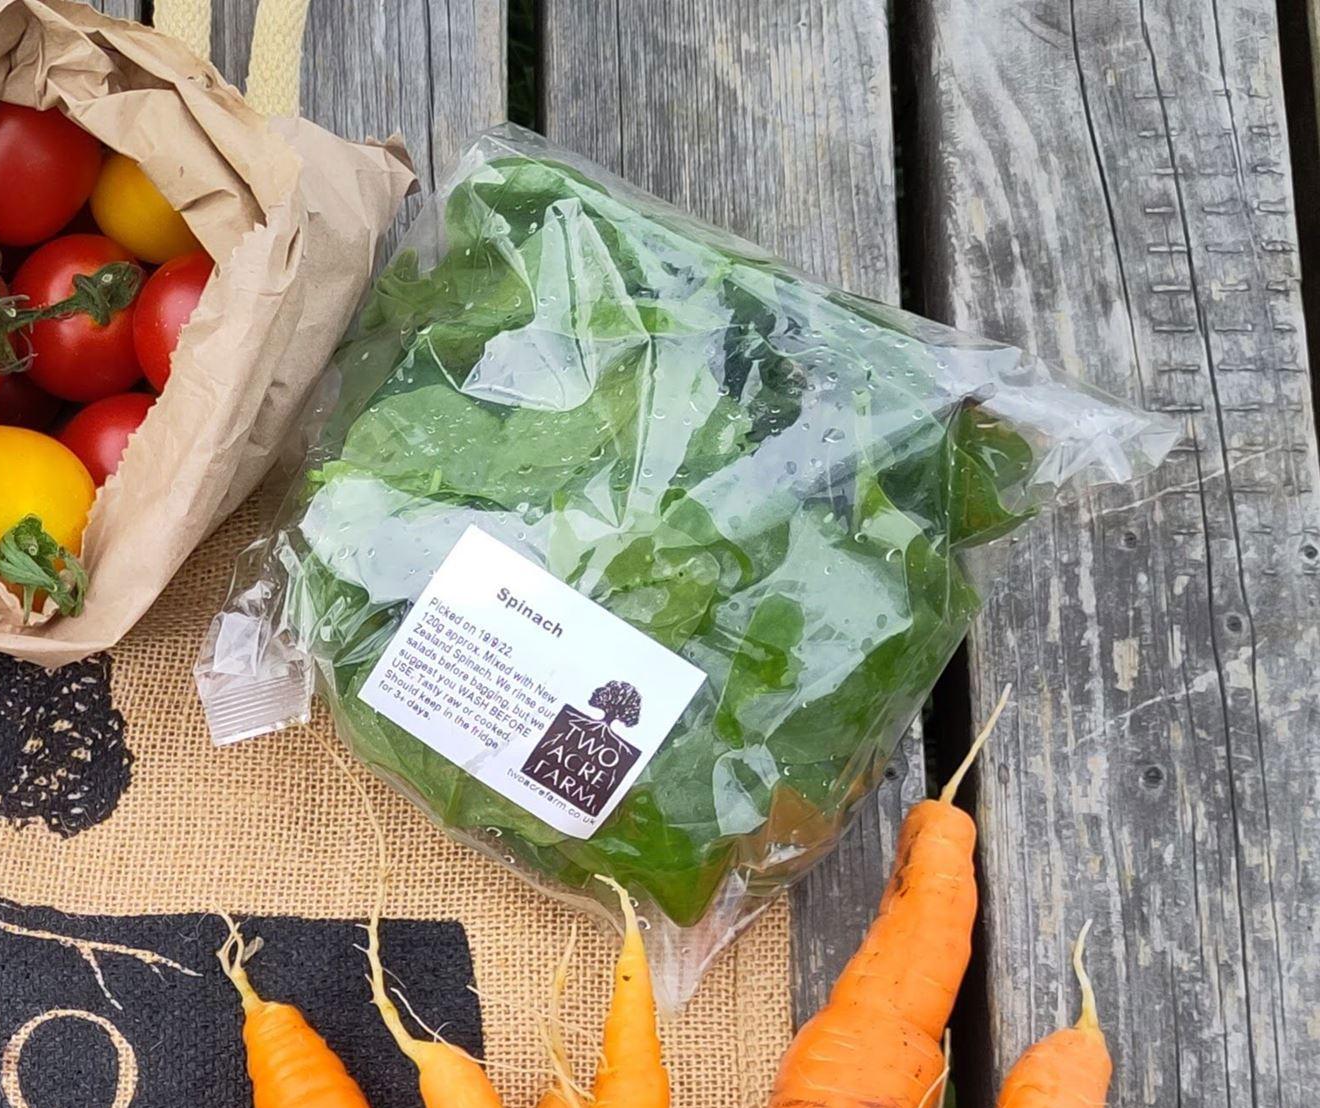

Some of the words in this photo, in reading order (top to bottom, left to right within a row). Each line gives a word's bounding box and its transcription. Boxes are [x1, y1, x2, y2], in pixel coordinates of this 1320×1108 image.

[427, 596, 465, 626] Picked
[461, 620, 478, 635] on
[493, 585, 566, 640] Spinach
[405, 634, 439, 661] salads
[437, 655, 471, 682] before
[510, 703, 531, 721] but
[528, 716, 546, 731] we
[412, 622, 454, 654] Zealand
[450, 647, 496, 682] Spinach.
[494, 675, 513, 692] We
[510, 685, 539, 709] rinse
[536, 704, 555, 720] our
[419, 610, 447, 634] 120g
[443, 627, 483, 658] approx.
[481, 649, 514, 676] Mixed
[511, 668, 536, 690] with
[533, 682, 559, 705] New
[377, 679, 394, 694] for
[404, 697, 434, 721] days.
[383, 668, 420, 696] Should
[416, 690, 444, 714] keep
[442, 707, 454, 719] in
[453, 714, 471, 730] the
[468, 725, 500, 751] fridge
[390, 657, 417, 679] USE.
[413, 673, 444, 698] Tasty
[442, 692, 462, 709] raw
[461, 705, 473, 717] or
[472, 711, 514, 743] cooked.
[396, 647, 438, 679] suggest
[435, 673, 456, 692] you
[456, 684, 490, 711] WASH
[488, 705, 532, 738] BEFORE
[545, 740, 608, 789] ACRE
[559, 721, 622, 771] TWO
[532, 757, 597, 808] FARM
